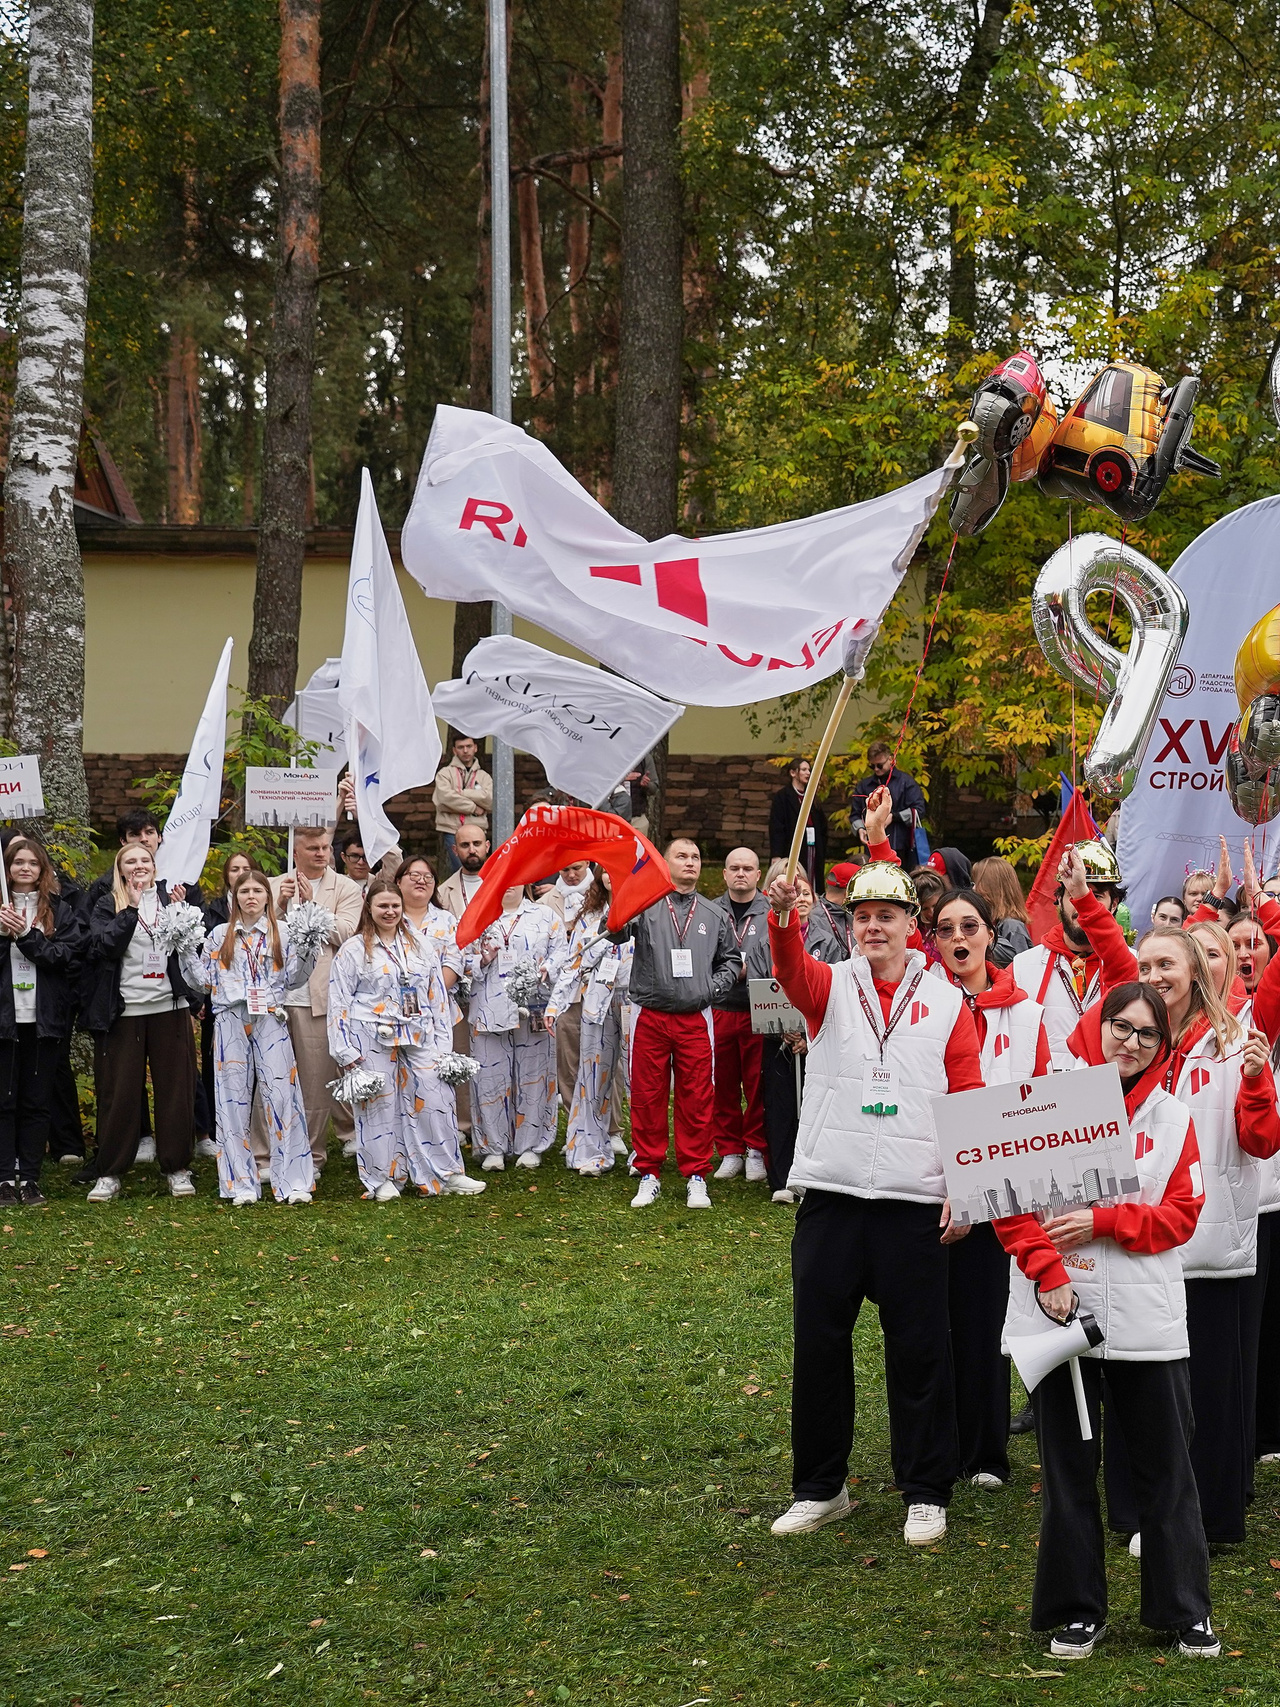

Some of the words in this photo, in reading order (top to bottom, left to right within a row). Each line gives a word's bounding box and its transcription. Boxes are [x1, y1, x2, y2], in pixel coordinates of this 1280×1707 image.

[1149, 769, 1224, 792] СТРОЙ
[1002, 1102, 1057, 1118] РЕНОВАЦИЯ
[988, 1121, 1120, 1160] РЕНОВАЦИЯ
